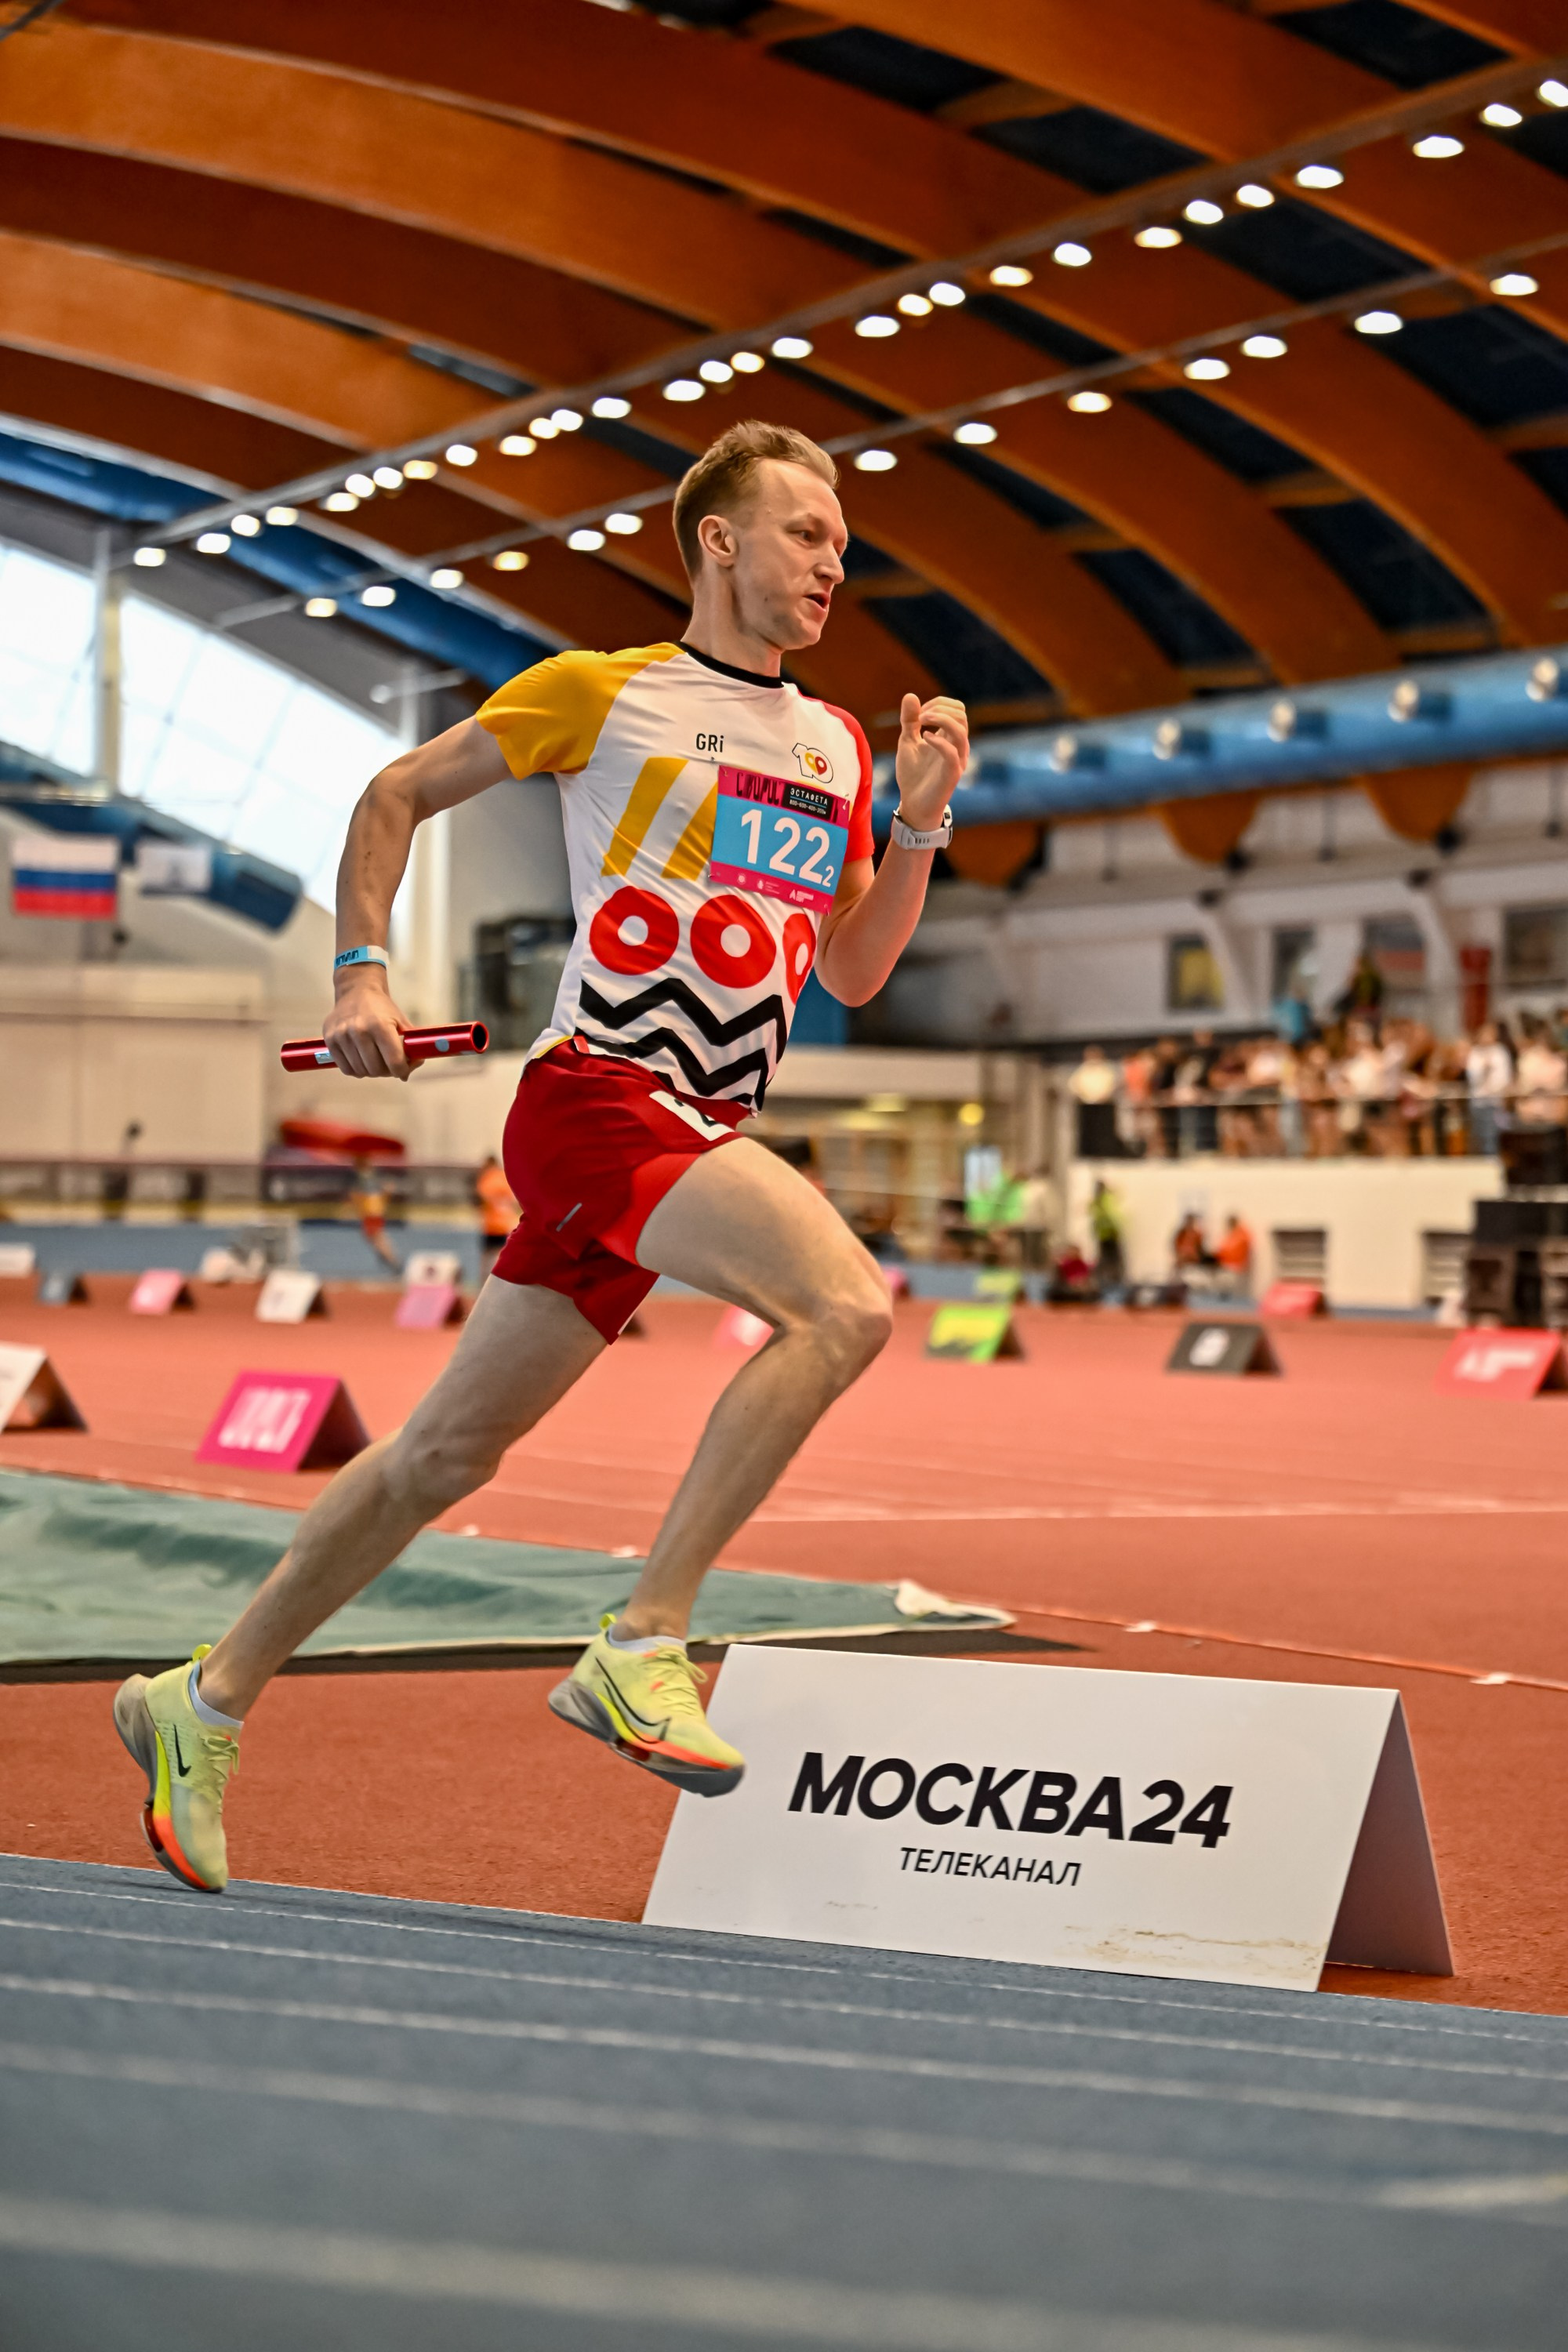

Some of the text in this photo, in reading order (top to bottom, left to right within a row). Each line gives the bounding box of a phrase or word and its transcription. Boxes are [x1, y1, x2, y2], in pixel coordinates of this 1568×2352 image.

[695, 733, 724, 753] GRi
[789, 787, 828, 806] ЭСТАФЕТА
[741, 808, 830, 885] 122
[787, 1751, 1234, 1849] МОСКВА24
[899, 1846, 1082, 1886] ТЕЛЕКАНАЛ
